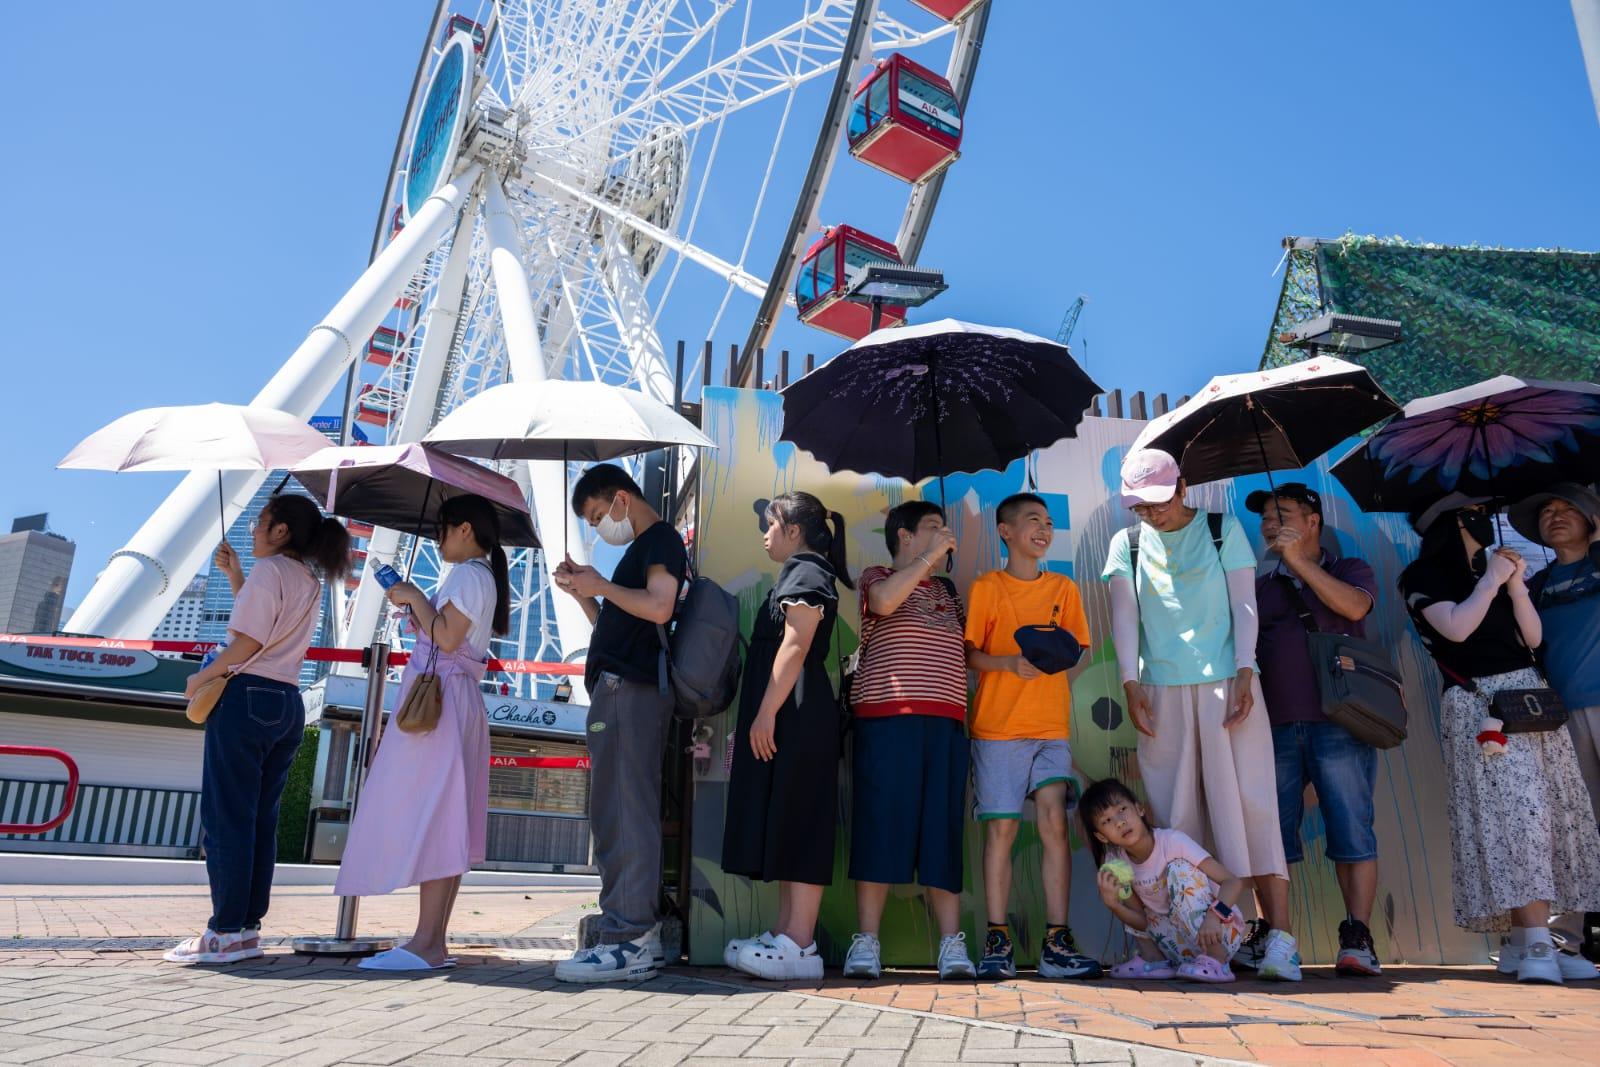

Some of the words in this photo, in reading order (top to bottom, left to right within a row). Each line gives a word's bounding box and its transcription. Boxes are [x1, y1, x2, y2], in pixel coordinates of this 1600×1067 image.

[922, 103, 938, 116] AIA
[0, 635, 28, 644] AIA
[98, 641, 125, 649] AIA
[26, 645, 54, 660] TAK
[58, 648, 95, 664] TUCK
[98, 652, 137, 667] SHOP
[504, 661, 526, 671] AIA
[493, 705, 541, 724] Chacha
[494, 758, 517, 766] AIA
[575, 759, 592, 769] AI
